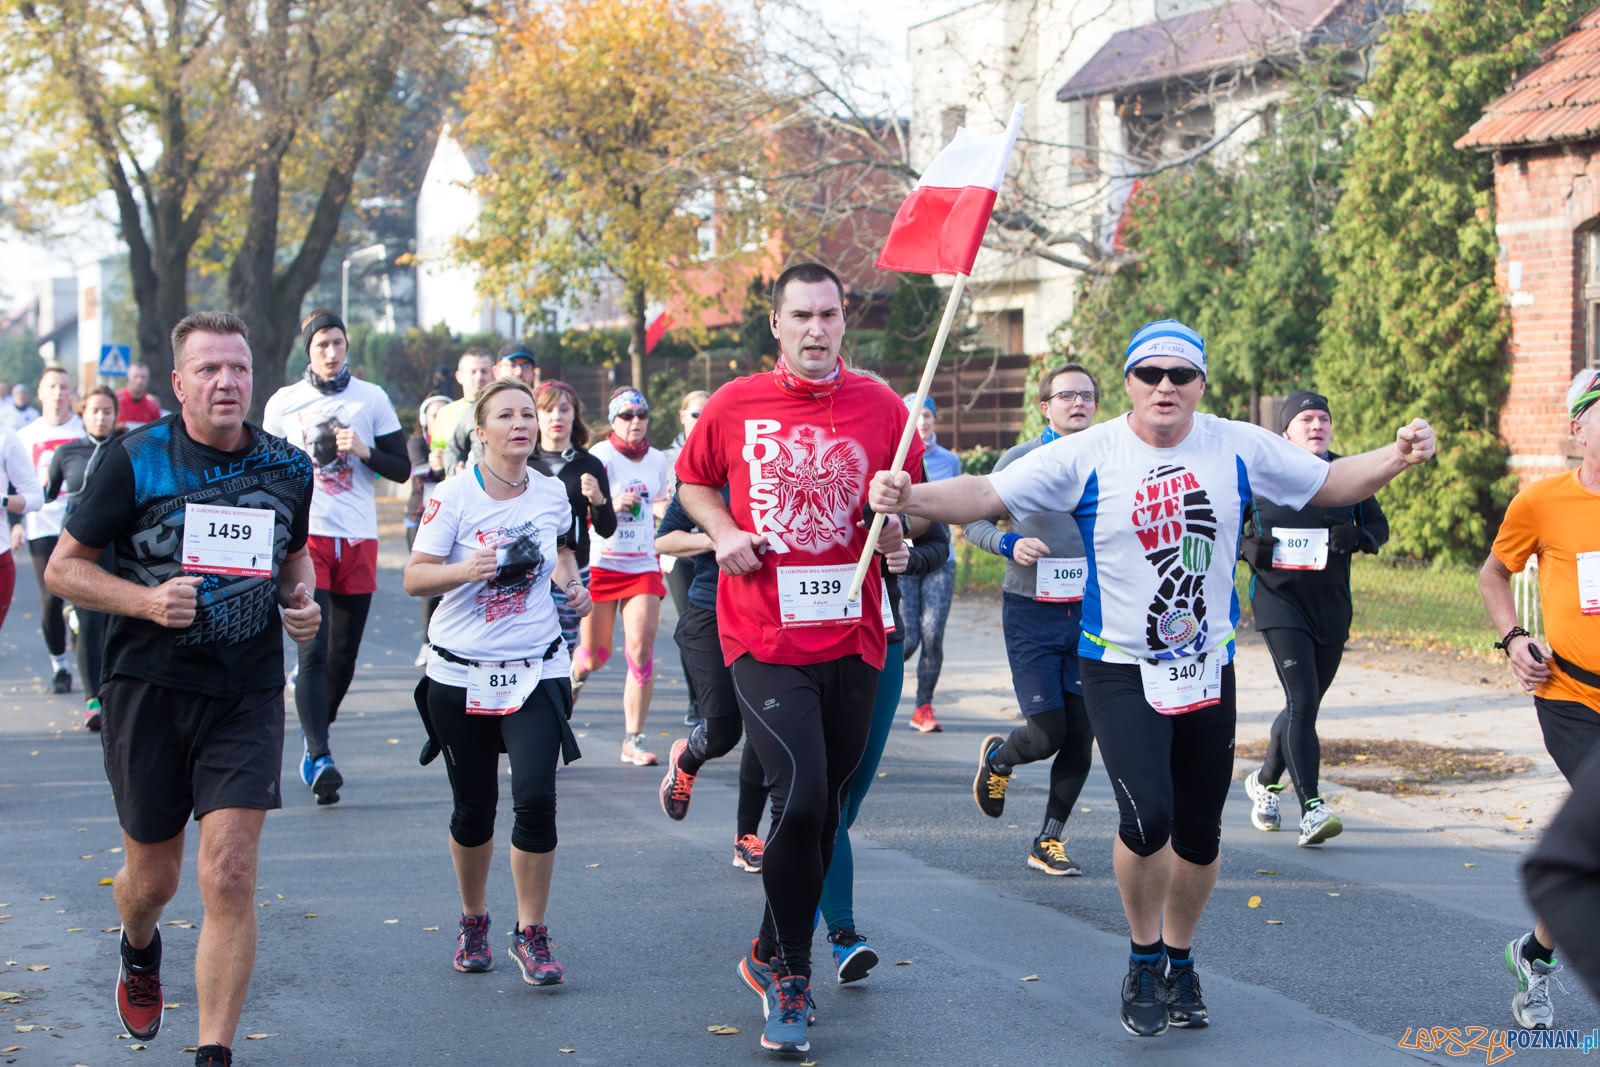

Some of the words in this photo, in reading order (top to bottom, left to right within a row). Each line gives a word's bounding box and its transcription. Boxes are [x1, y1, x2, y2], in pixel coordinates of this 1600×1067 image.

[223, 472, 259, 494] bike
[742, 419, 790, 554] POLSKA
[1134, 471, 1201, 507] ŚWIER
[1131, 496, 1182, 528] CZE
[207, 522, 252, 540] 1459
[618, 529, 635, 539] 350
[1135, 520, 1182, 551] WO
[1287, 538, 1309, 548] 807
[1182, 535, 1214, 574] RUN
[1054, 568, 1083, 580] 1069
[799, 579, 842, 595] 1339
[489, 673, 518, 688] 814
[1168, 663, 1197, 682] 340
